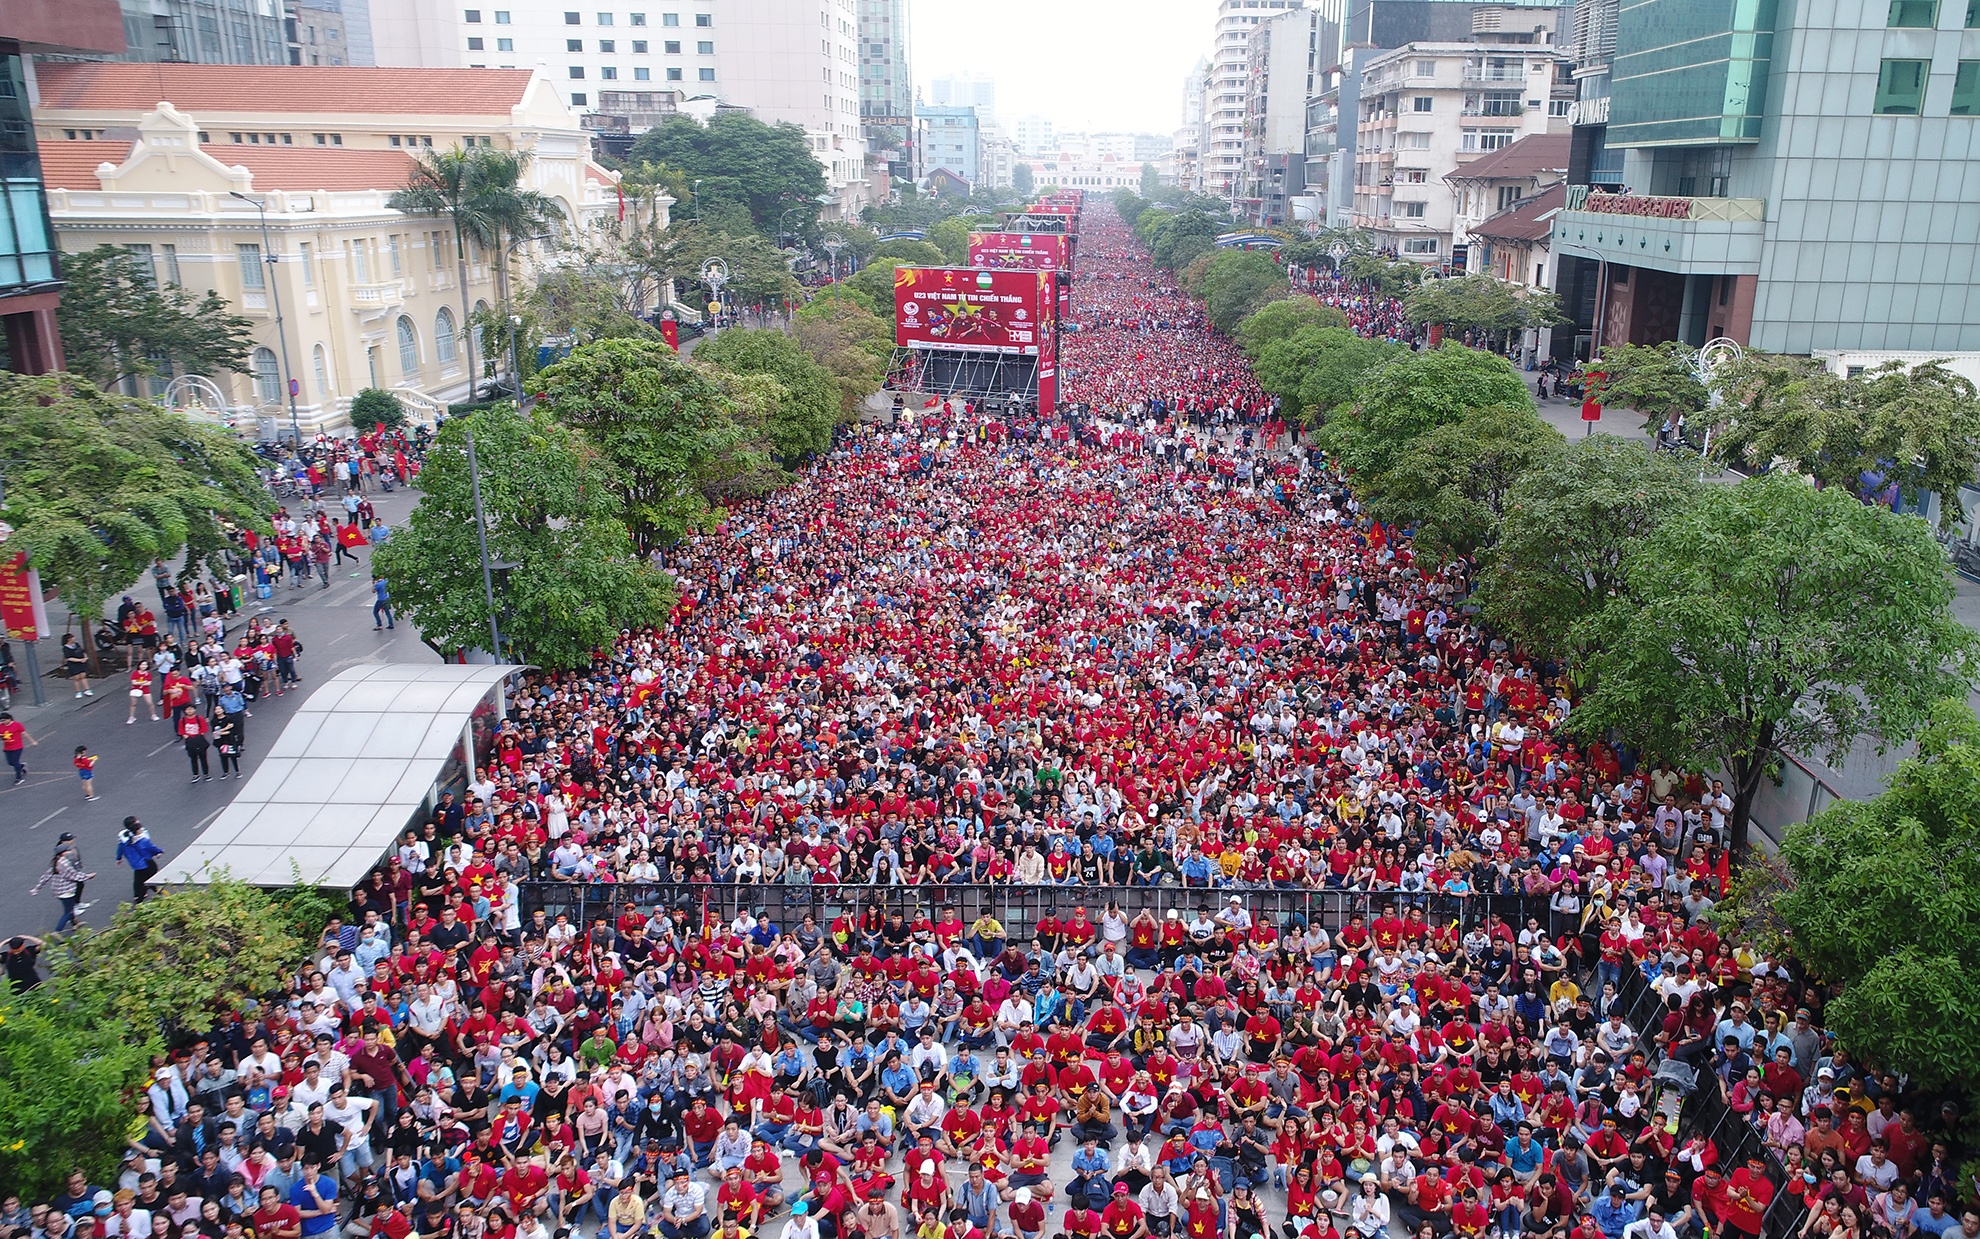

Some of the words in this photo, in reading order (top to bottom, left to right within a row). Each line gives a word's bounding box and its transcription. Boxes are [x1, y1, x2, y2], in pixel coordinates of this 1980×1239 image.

[1585, 194, 1613, 214] OFFICE
[1614, 195, 1649, 217] SERVICE
[1649, 197, 1690, 219] CENTER
[914, 291, 927, 299] U23
[927, 291, 941, 301] VIỆT
[958, 293, 967, 302] TỰ
